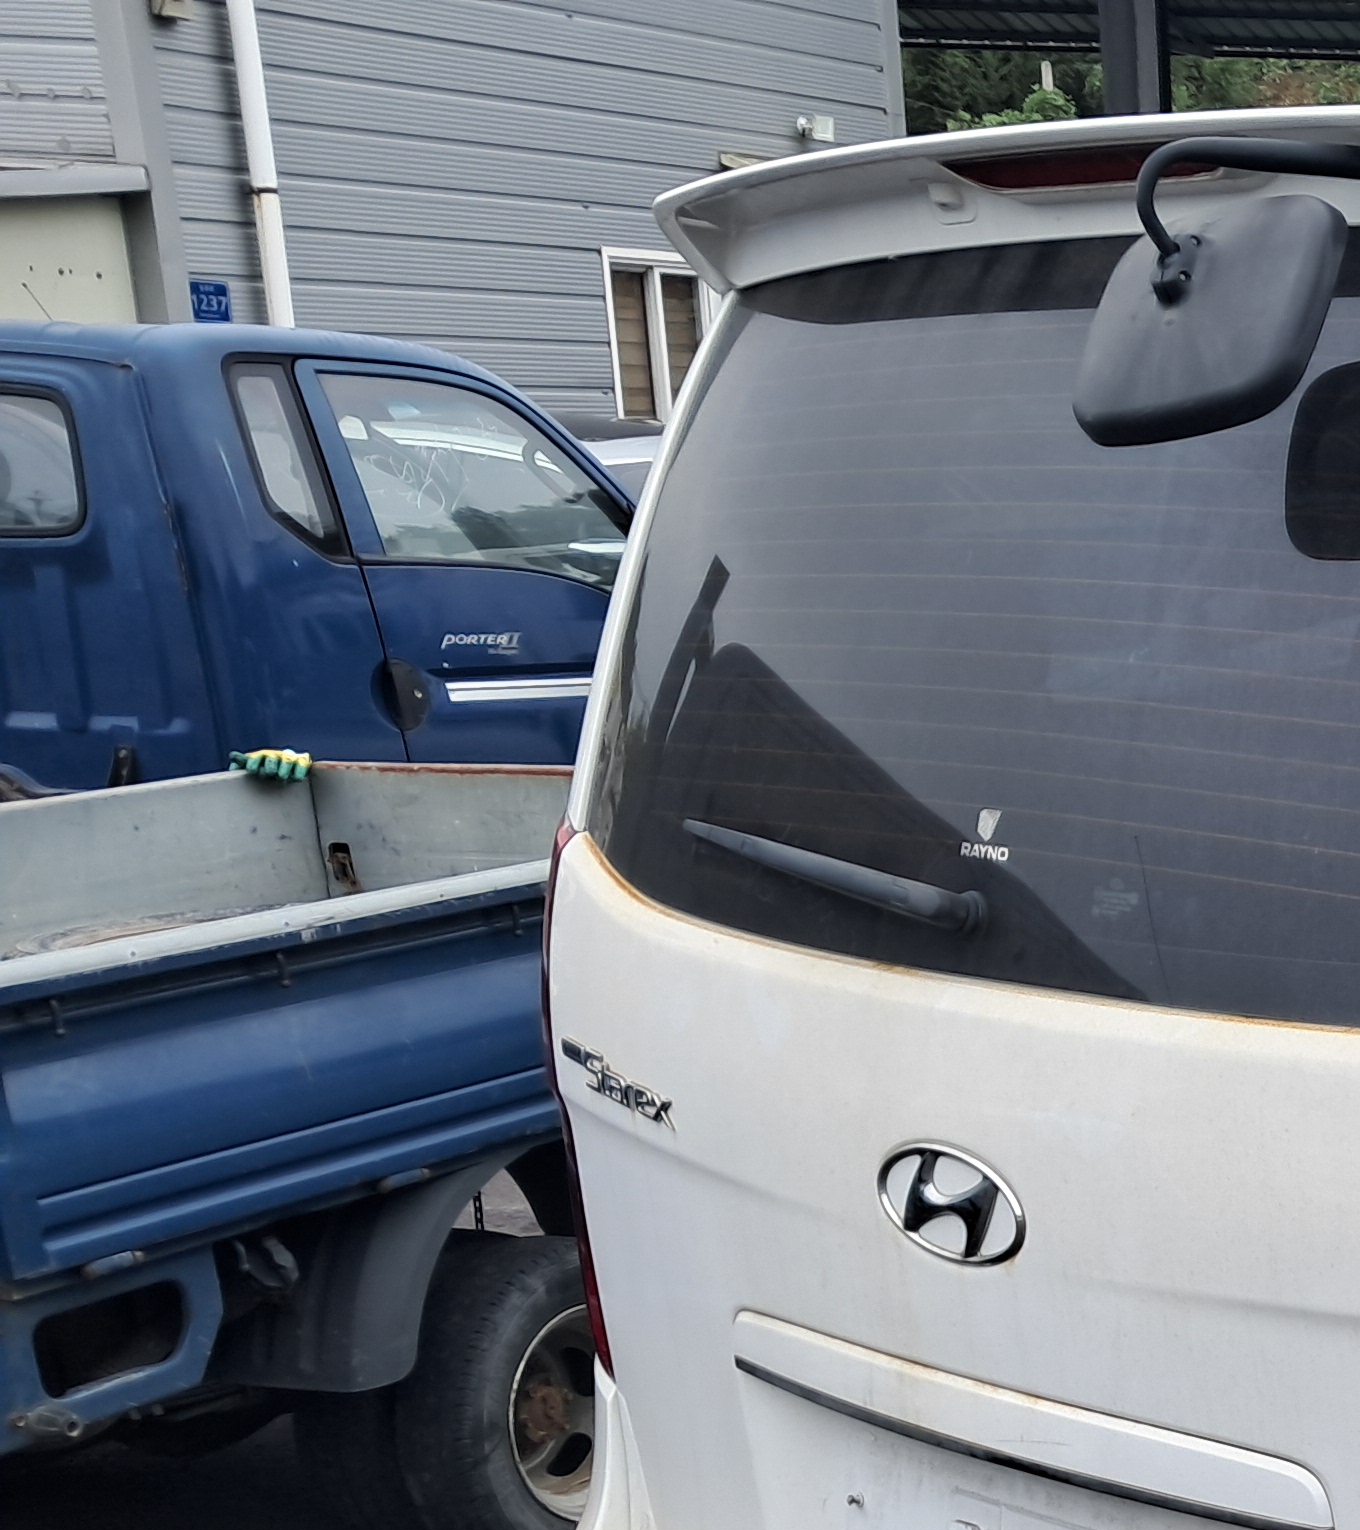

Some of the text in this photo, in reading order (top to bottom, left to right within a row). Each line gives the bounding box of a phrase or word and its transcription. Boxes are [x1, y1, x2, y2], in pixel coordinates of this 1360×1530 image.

[191, 293, 227, 312] 1237
[440, 633, 507, 650] PORTER
[960, 841, 1009, 862] RAYNO
[585, 1050, 676, 1132] Starex
